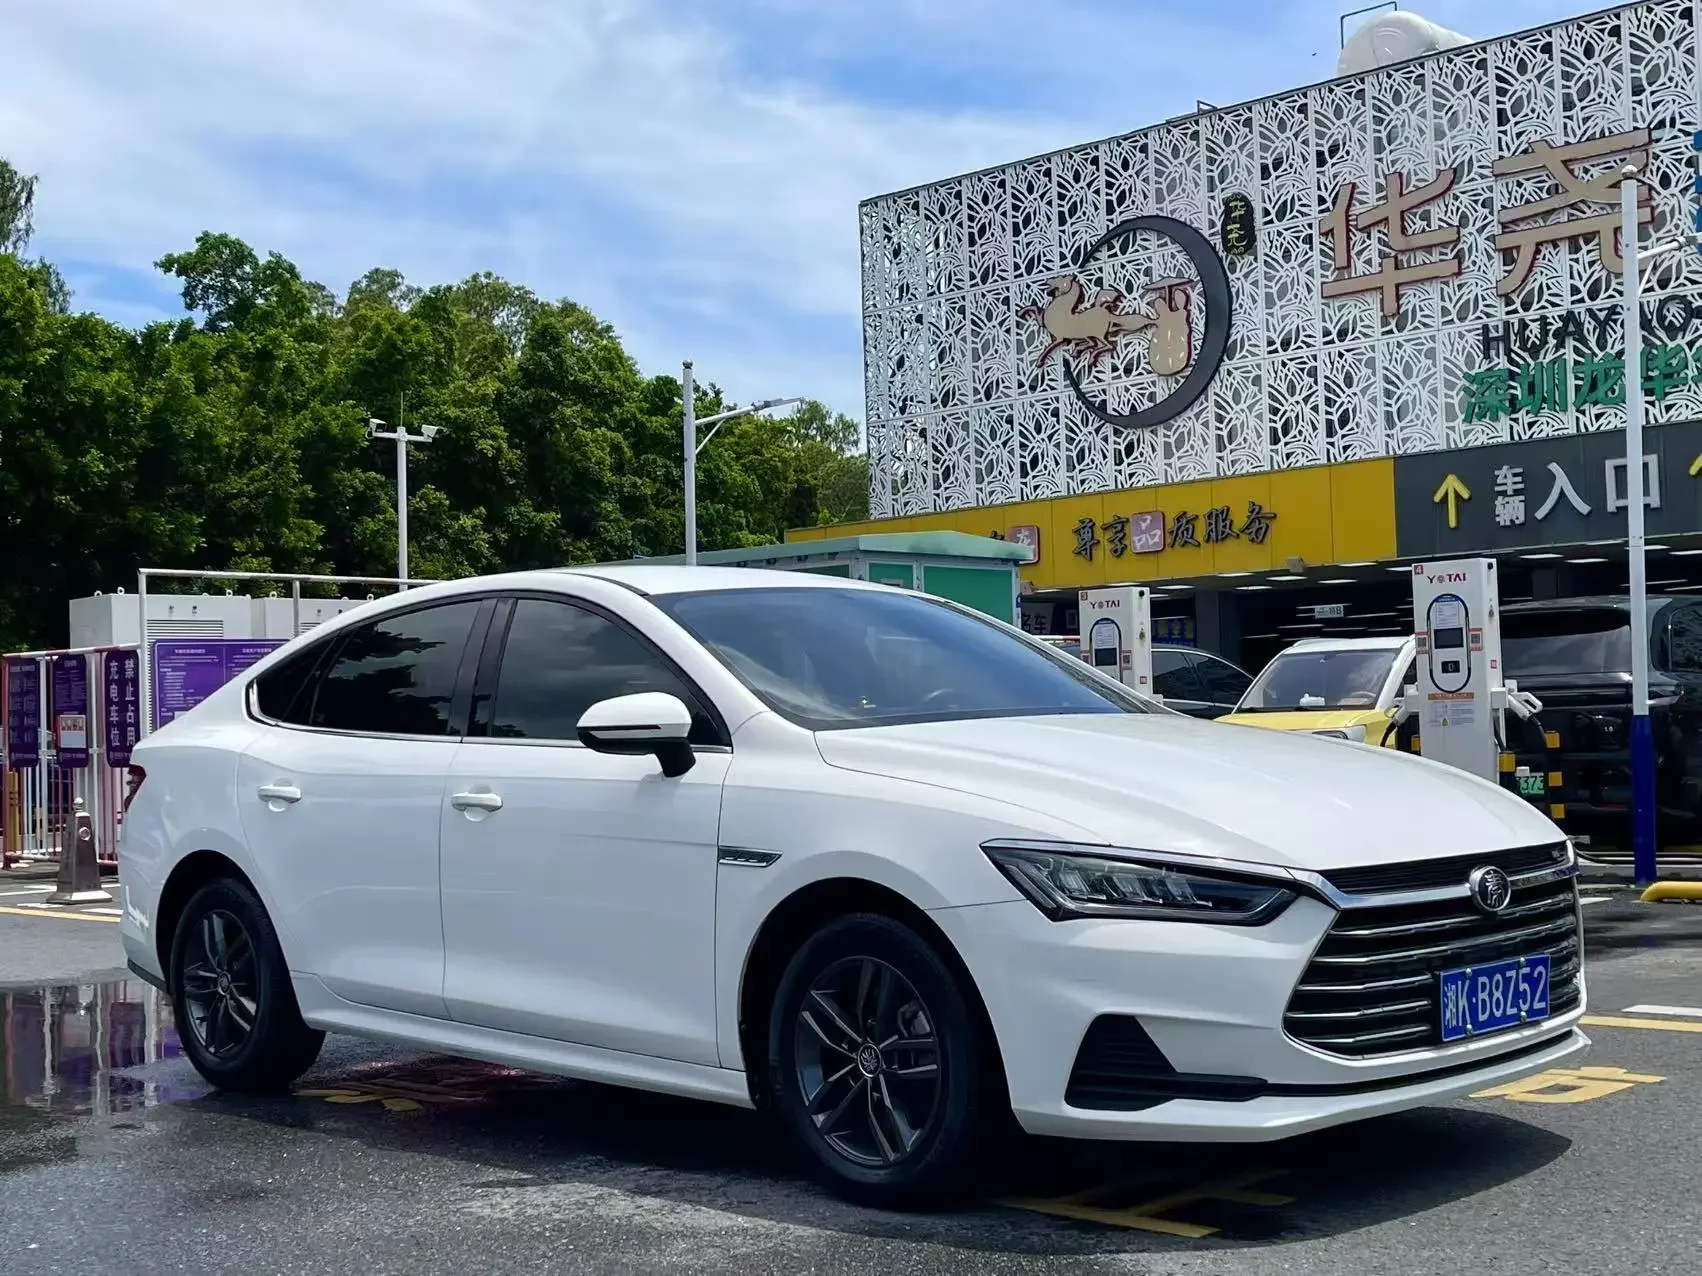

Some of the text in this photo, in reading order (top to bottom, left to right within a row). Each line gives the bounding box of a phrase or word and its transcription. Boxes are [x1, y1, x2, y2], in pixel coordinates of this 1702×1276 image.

[1072, 501, 1277, 561] 尊享品质服务
[109, 660, 121, 747] 充电车位
[124, 658, 137, 747] 禁止占用
